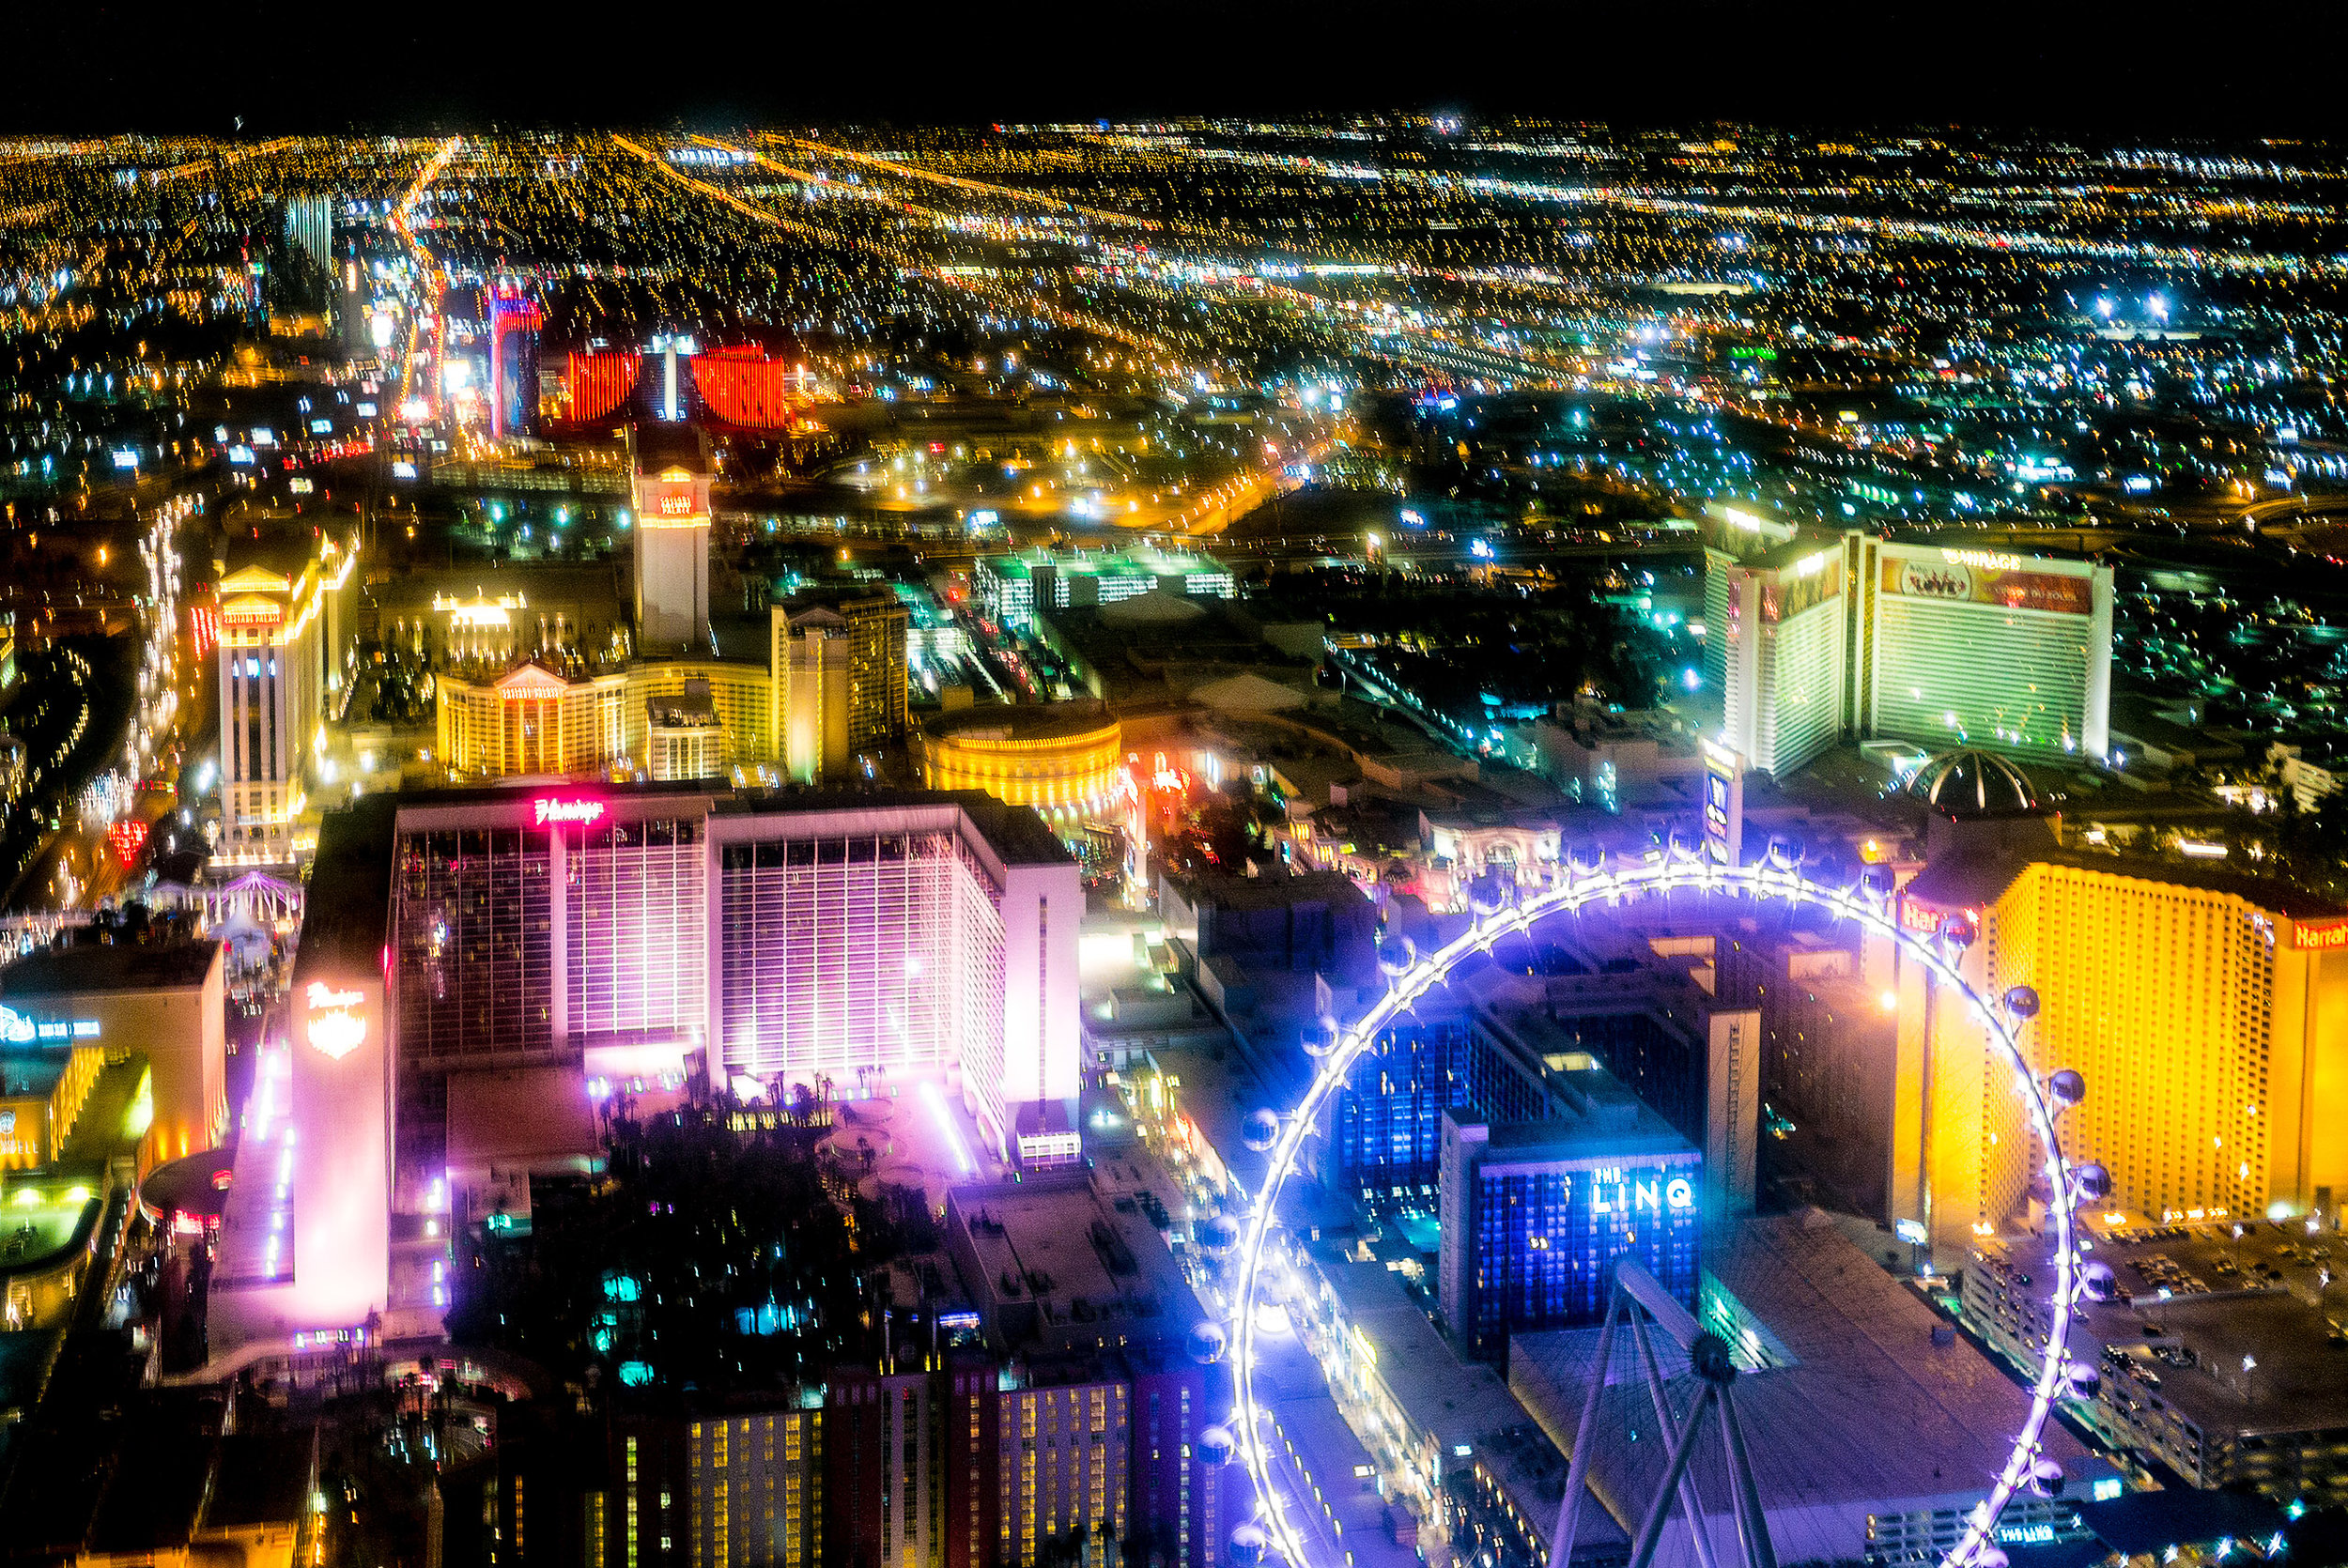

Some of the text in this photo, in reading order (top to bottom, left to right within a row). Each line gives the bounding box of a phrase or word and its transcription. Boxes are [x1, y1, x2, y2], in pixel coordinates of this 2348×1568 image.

[1960, 548, 2022, 571] MIRAGE
[533, 797, 604, 826] Flamingo
[1594, 1166, 1621, 1184] THE
[1593, 1177, 1692, 1214] LINQ
